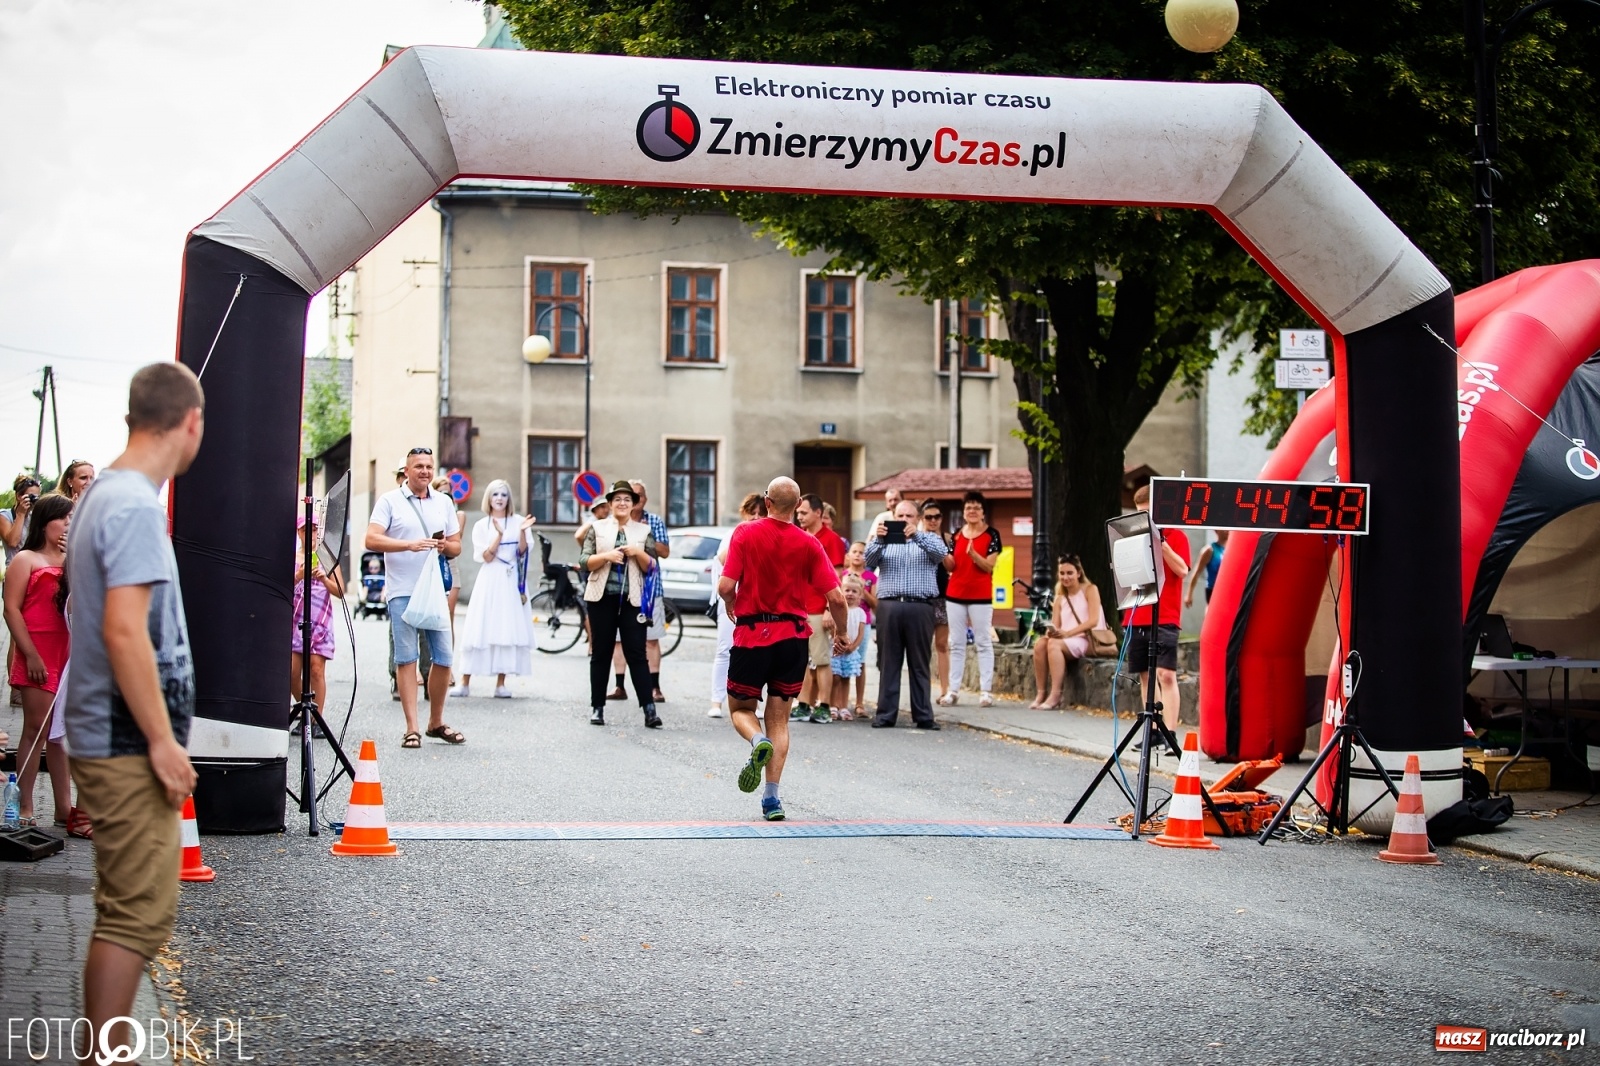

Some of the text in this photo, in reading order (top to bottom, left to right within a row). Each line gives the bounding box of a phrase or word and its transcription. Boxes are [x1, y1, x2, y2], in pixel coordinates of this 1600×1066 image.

[714, 75, 1052, 110] Elektroniczny pomiar czasu
[706, 116, 1068, 177] ZmierzymyCzas.pl
[1182, 482, 1366, 530] 0 44 58
